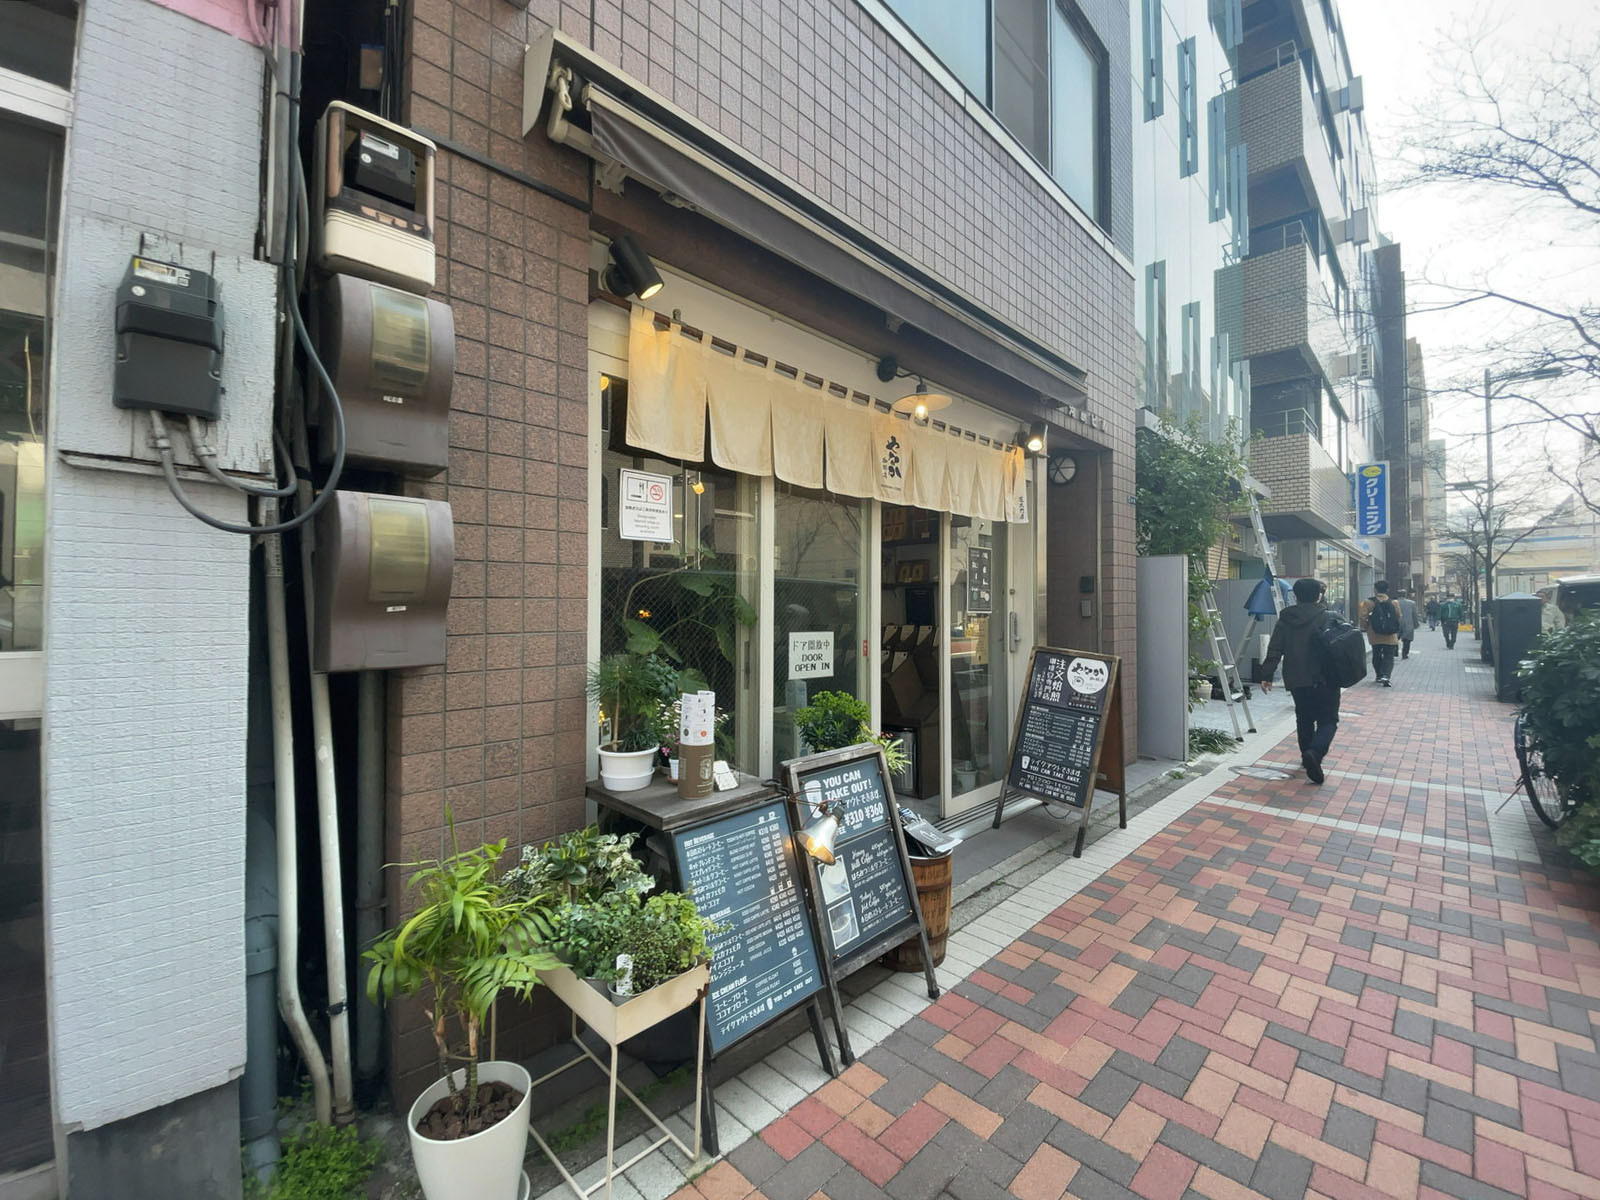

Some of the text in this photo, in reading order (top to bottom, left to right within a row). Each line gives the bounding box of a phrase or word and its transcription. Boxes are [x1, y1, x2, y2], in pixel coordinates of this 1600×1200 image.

[1366, 478, 1381, 534] クリーニング
[795, 664, 816, 672] OPEN
[802, 653, 823, 662] DOOR
[1050, 659, 1066, 702] 注文焙煎
[823, 770, 861, 789] YOU CAN
[825, 779, 872, 800] TAKE OUT!
[844, 809, 864, 826] ¥310
[865, 802, 884, 818] ¥360
[712, 943, 741, 962] イスカフェモカ
[714, 989, 748, 1012] コーヒーフロート
[716, 997, 749, 1020] ココアフロート
